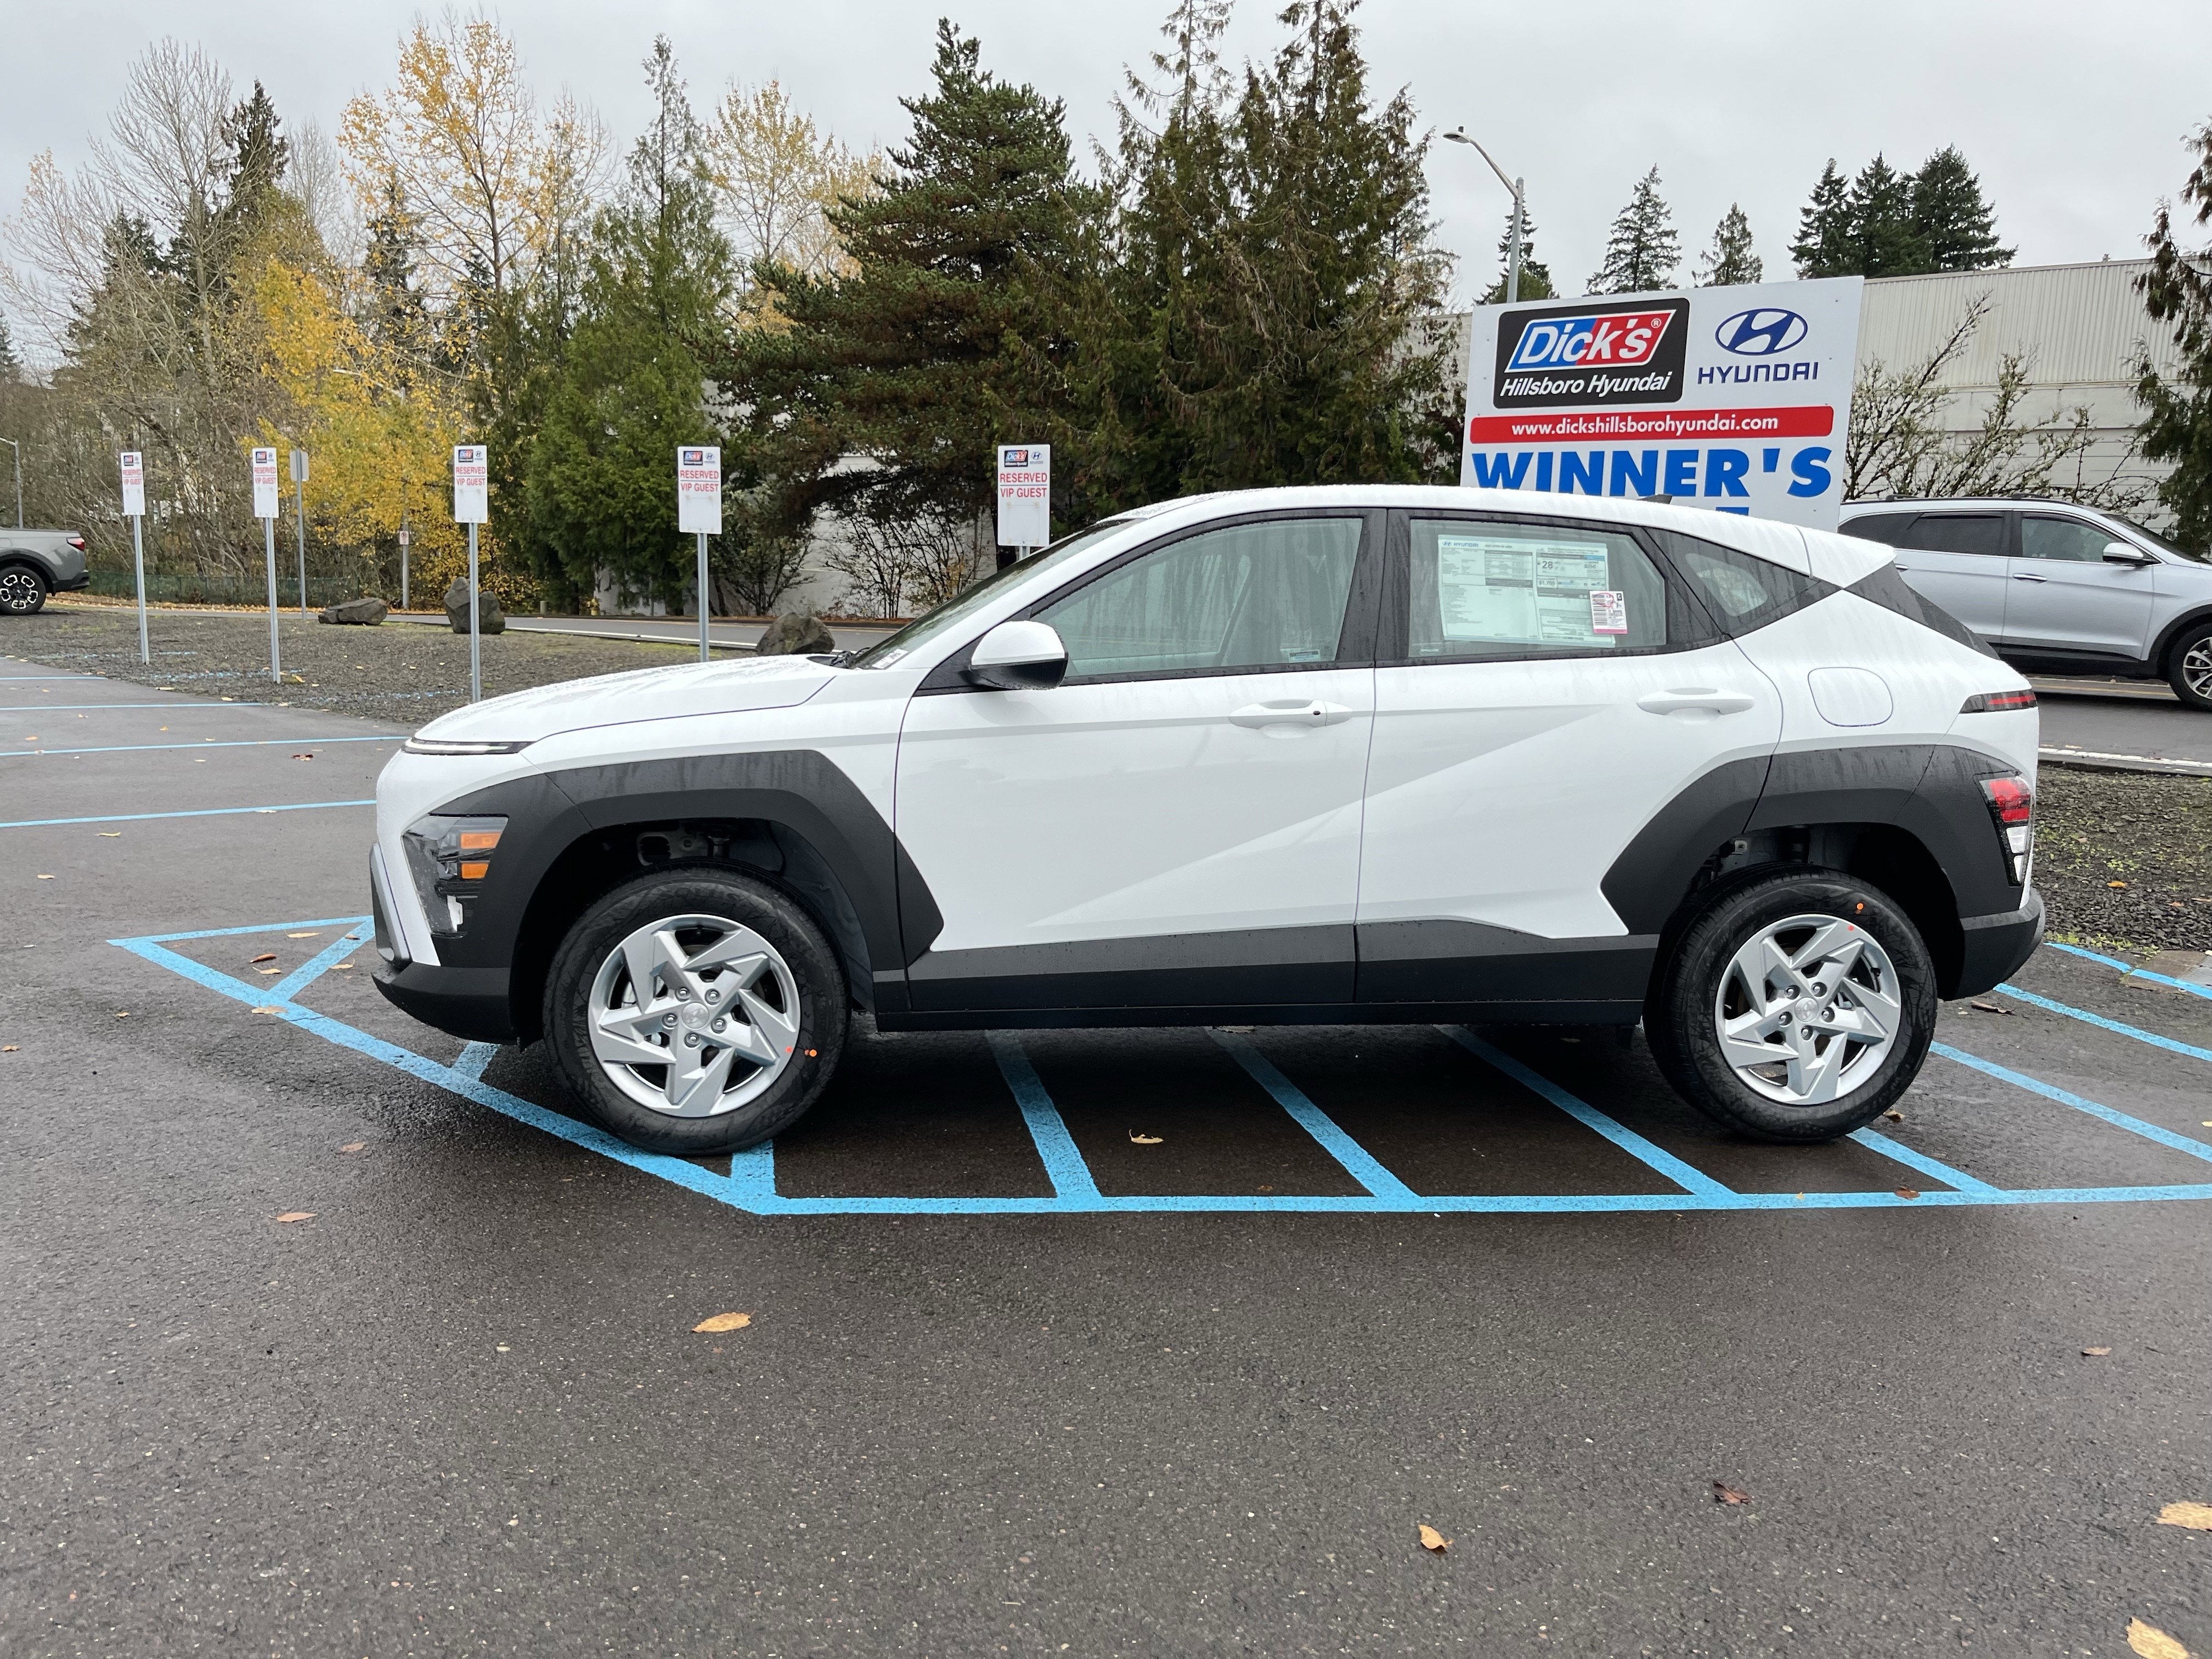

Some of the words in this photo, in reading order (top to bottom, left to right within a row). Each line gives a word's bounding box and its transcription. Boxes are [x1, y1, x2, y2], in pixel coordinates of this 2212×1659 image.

[1517, 318, 1652, 364] Dick's
[1697, 362, 1819, 385] HYUNDAI
[1499, 376, 1585, 397] Hillsboro
[1587, 371, 1673, 398] Hyundai
[1511, 413, 1778, 436] www.dickshillsborohyundai.com
[680, 470, 719, 479] RESERVED
[1000, 473, 1047, 483] RESERVED
[1471, 447, 1832, 498] WINNER'S
[680, 483, 692, 492] VIP
[694, 483, 719, 492] GUEST
[1000, 488, 1014, 498] VIP
[1017, 488, 1047, 498] GUEST
[1542, 561, 1553, 569] 28
